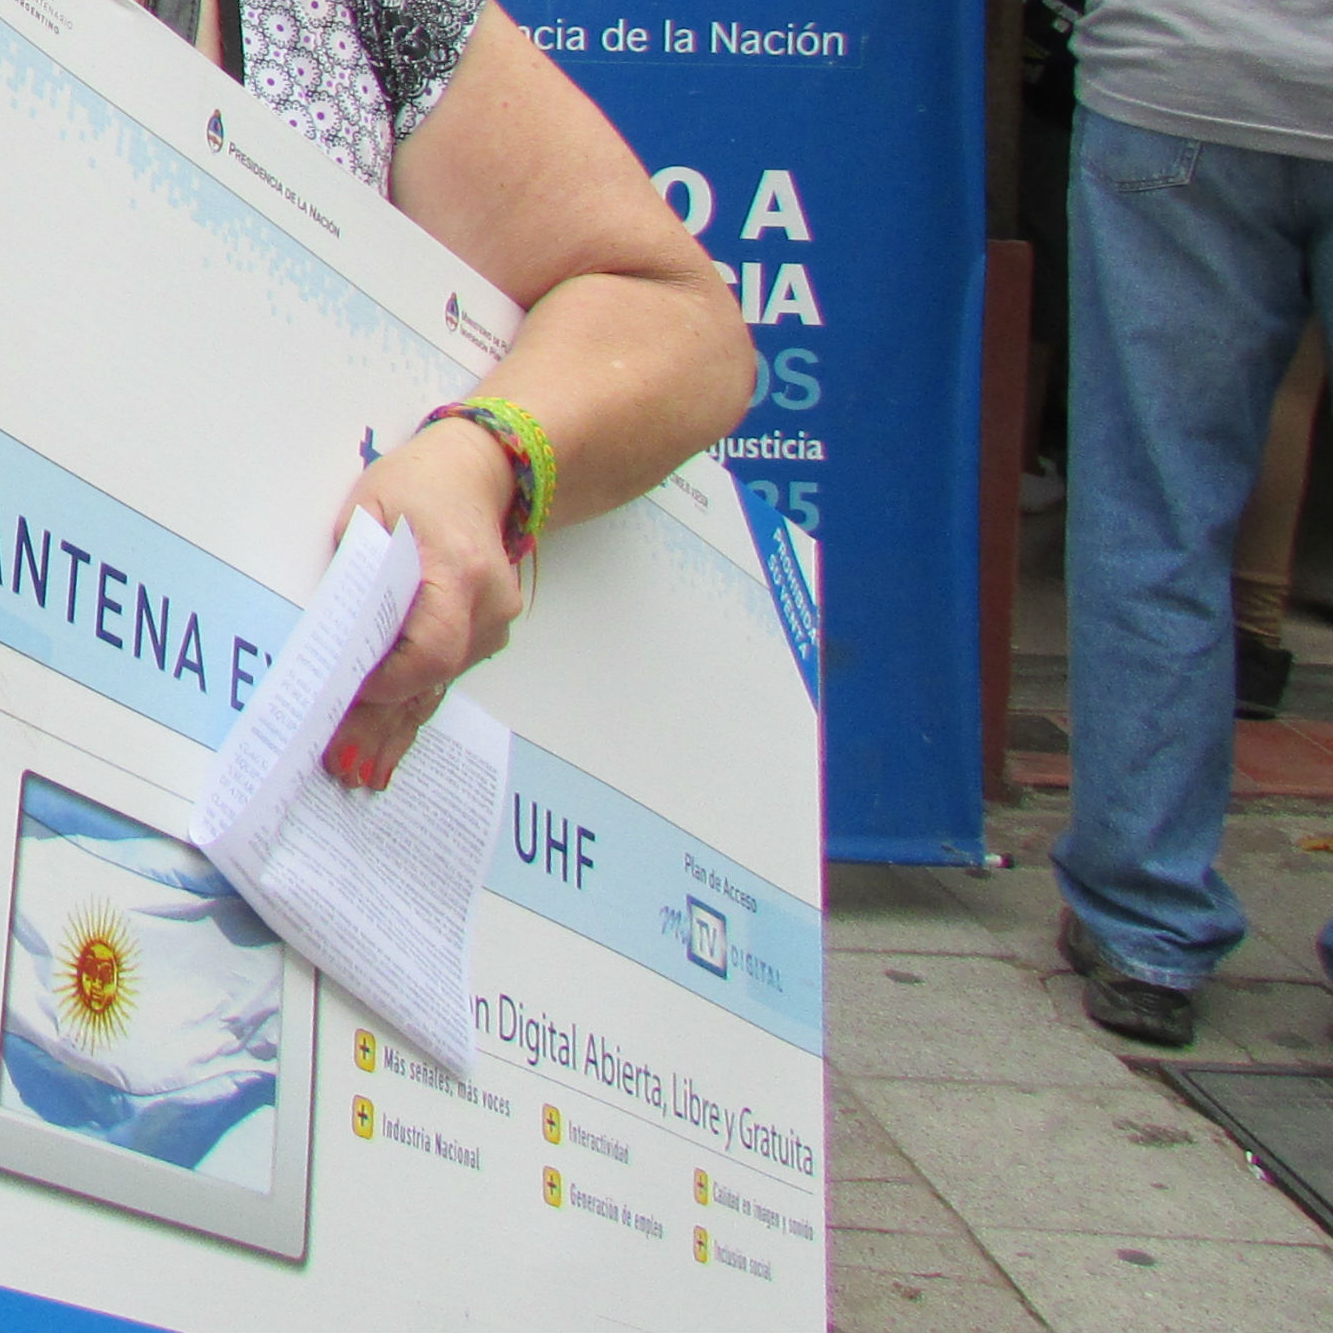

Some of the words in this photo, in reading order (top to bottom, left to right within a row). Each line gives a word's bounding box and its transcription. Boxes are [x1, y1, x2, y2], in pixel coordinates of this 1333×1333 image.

[600, 19, 648, 53] de
[663, 19, 694, 54] la
[709, 18, 844, 57] Nación
[739, 168, 812, 242] A
[512, 791, 597, 891] UHF
[683, 852, 708, 885] Plan
[708, 867, 723, 891] de
[722, 875, 758, 914] Acceso
[695, 917, 719, 959] TV
[729, 943, 785, 994] DIGITAL
[383, 1045, 406, 1077] Más
[409, 1061, 454, 1098] señales,
[456, 1078, 479, 1106] más
[482, 1090, 511, 1118] voces
[497, 992, 577, 1072] Digital
[583, 1032, 668, 1119] Abierta,
[671, 1071, 721, 1137] Libre
[723, 1107, 736, 1152] y
[738, 1106, 815, 1177] Gratuita
[382, 1112, 432, 1153] Industria
[434, 1131, 481, 1171] Nacional
[568, 1118, 630, 1165] Interactividad
